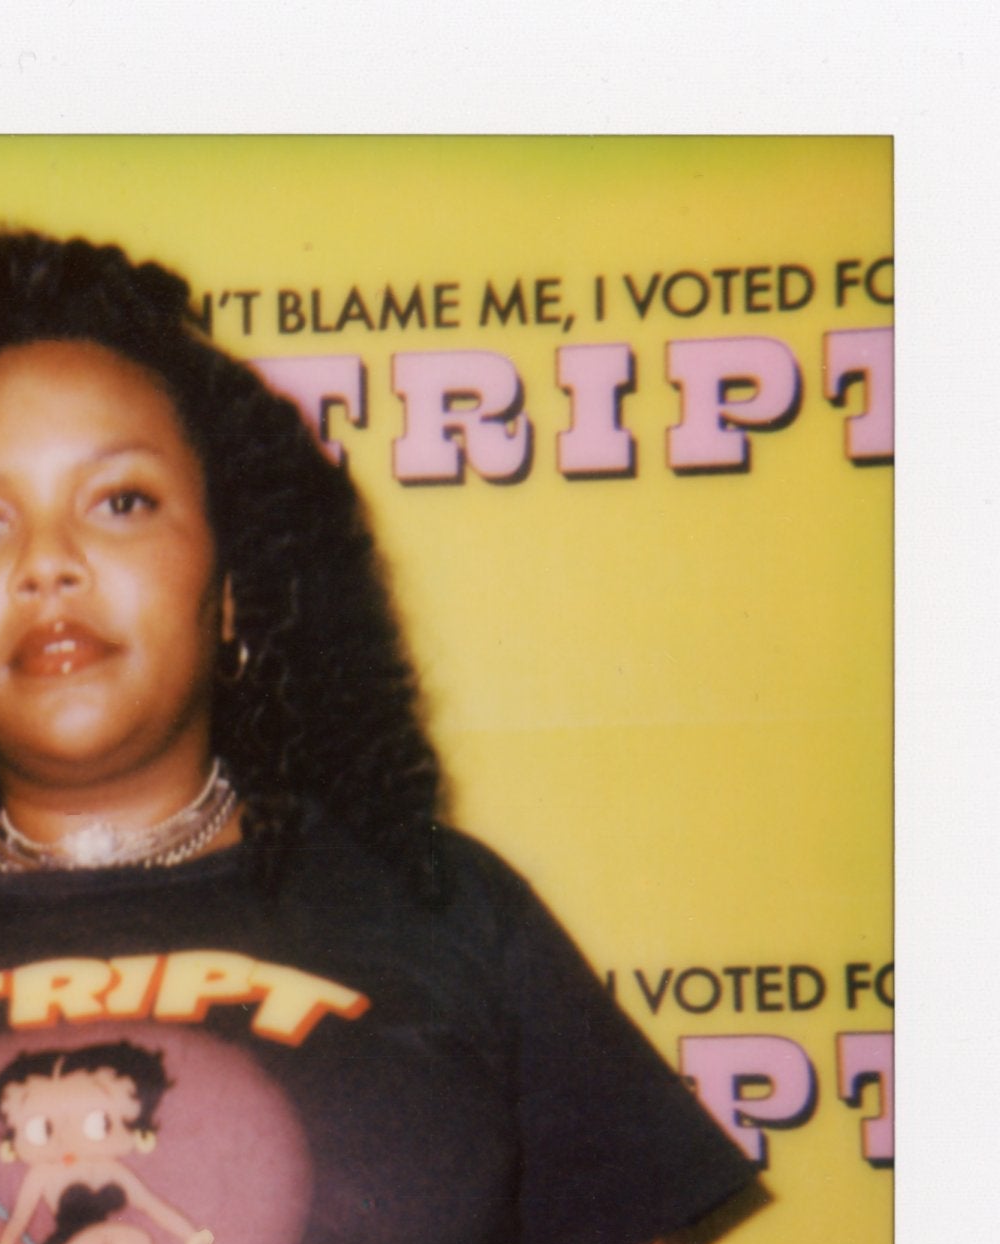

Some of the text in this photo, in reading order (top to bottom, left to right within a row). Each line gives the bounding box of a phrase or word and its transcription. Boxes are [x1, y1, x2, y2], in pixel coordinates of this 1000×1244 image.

[277, 282, 460, 335] BLAME
[479, 278, 575, 334] ME,
[596, 276, 606, 321] I
[624, 264, 816, 321] VOTED
[633, 964, 826, 1015] VOTED
